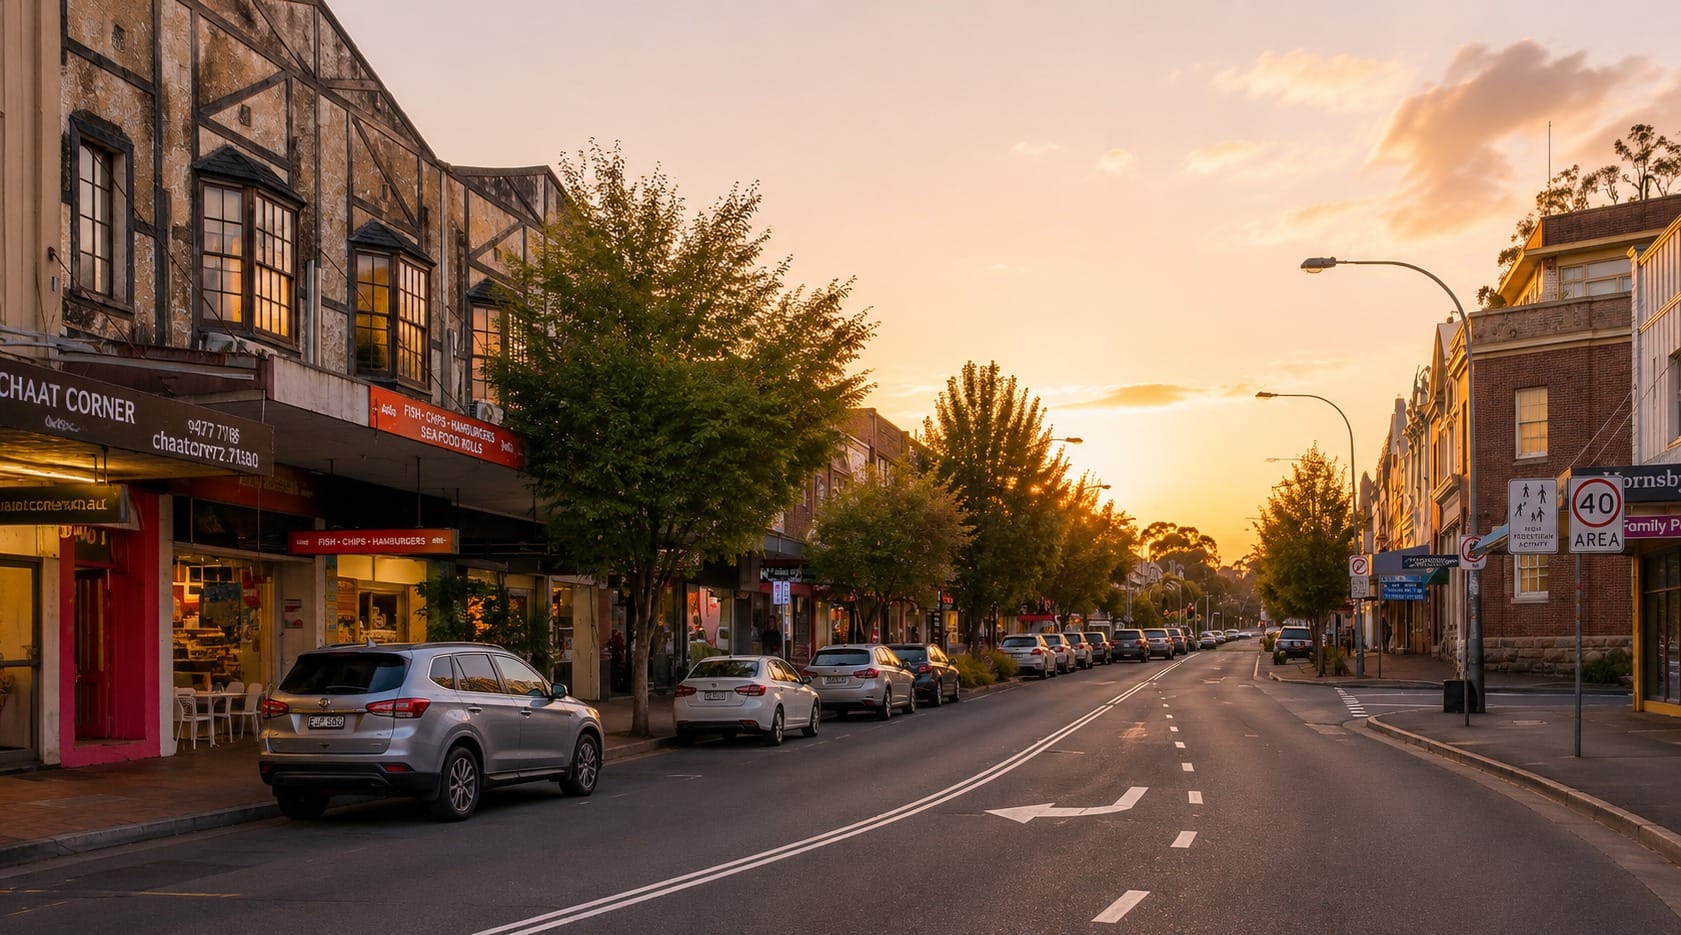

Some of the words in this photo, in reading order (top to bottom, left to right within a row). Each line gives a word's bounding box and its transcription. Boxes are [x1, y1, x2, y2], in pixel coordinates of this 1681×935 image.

[0, 372, 60, 408] CHAAT
[66, 387, 136, 425] CORNER
[404, 404, 421, 420] FISH
[425, 411, 447, 428] CHIPS
[461, 438, 483, 454] ROLLS
[1579, 492, 1614, 515] 40
[1670, 518, 1681, 532] P
[317, 538, 336, 546] FISH
[342, 538, 367, 546] CHIPS
[372, 537, 426, 546] HAMBURGERS
[1574, 532, 1620, 547] AREA
